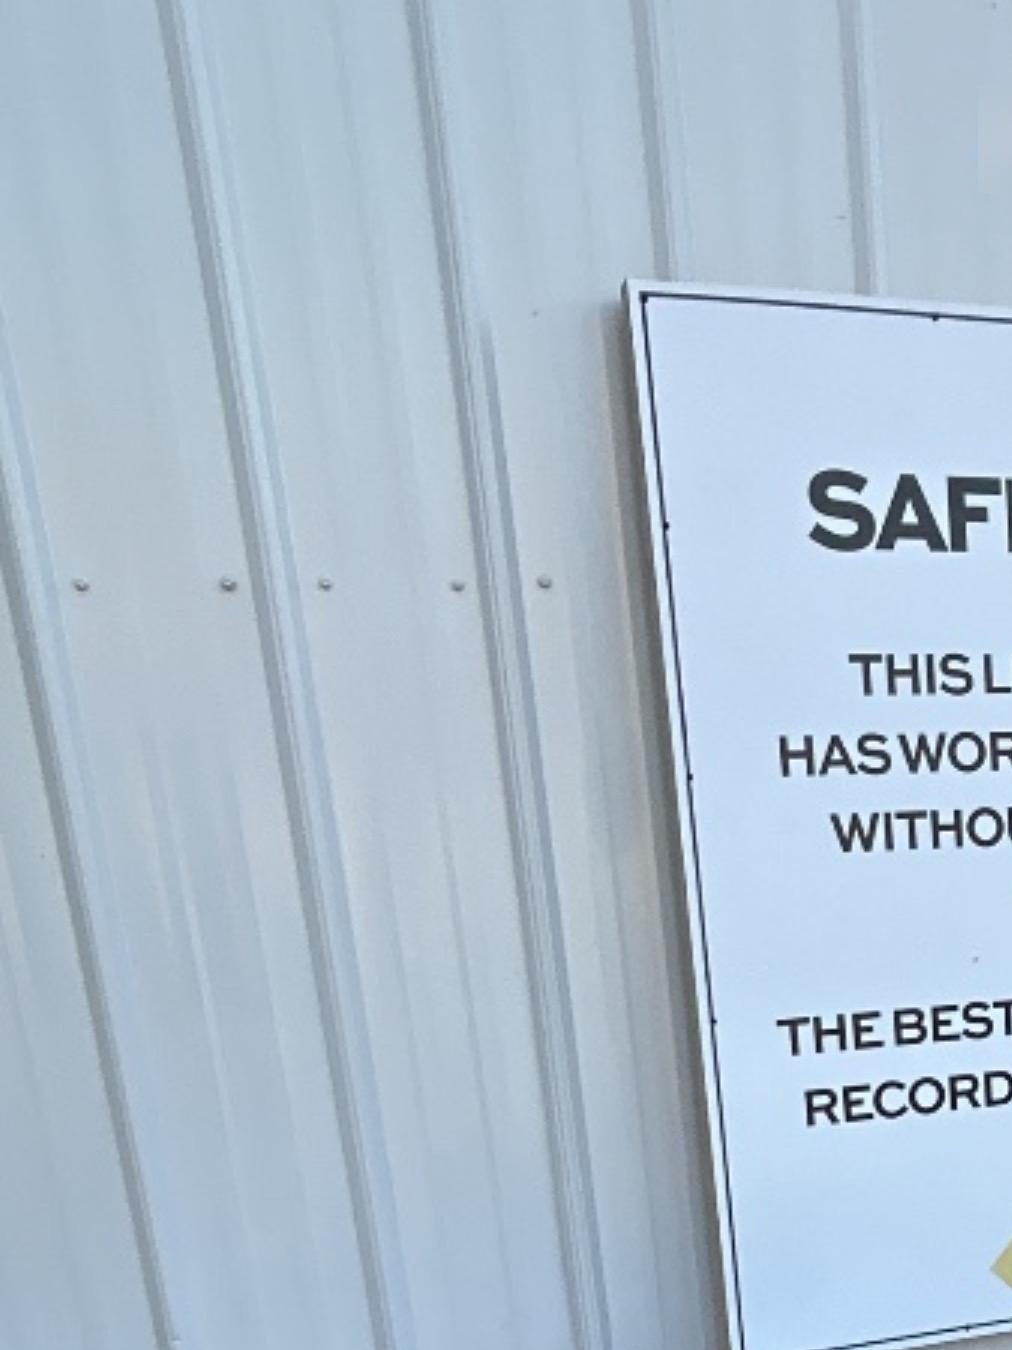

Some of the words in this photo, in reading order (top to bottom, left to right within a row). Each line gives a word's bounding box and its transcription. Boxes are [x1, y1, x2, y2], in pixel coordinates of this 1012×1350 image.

[848, 653, 973, 696] THIS
[779, 735, 891, 777] HAS
[776, 1011, 885, 1056] THE
